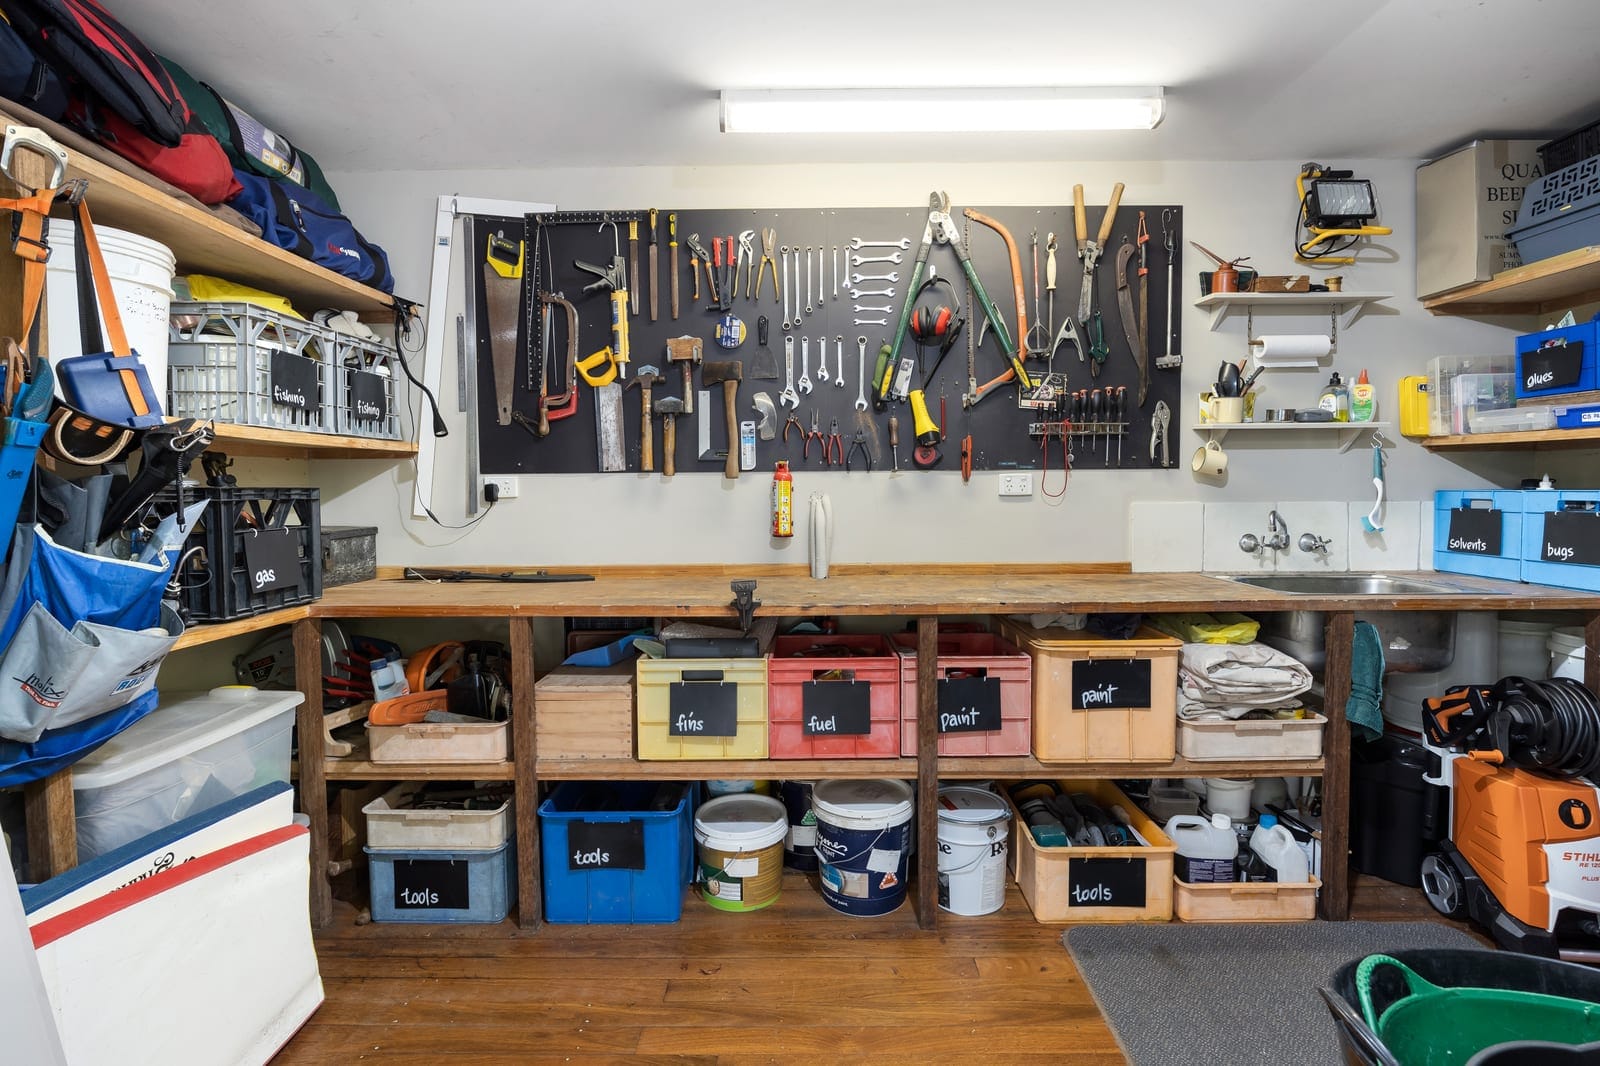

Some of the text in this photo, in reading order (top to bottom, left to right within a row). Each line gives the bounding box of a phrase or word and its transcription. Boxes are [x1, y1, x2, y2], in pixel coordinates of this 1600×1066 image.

[1487, 187, 1526, 202] BEE
[1526, 371, 1554, 388] glues
[274, 384, 306, 407] fishing
[357, 399, 380, 420] fishing
[1449, 537, 1487, 551] solvents
[1547, 542, 1575, 561] bugs
[255, 569, 276, 589] gas
[1081, 683, 1119, 708] paint
[675, 711, 704, 732] fins
[807, 715, 837, 732] fuel
[940, 706, 981, 732] paint
[573, 848, 610, 866] tools
[1562, 852, 1600, 862] STIHL
[400, 887, 439, 906] tools
[1072, 883, 1112, 903] tools
